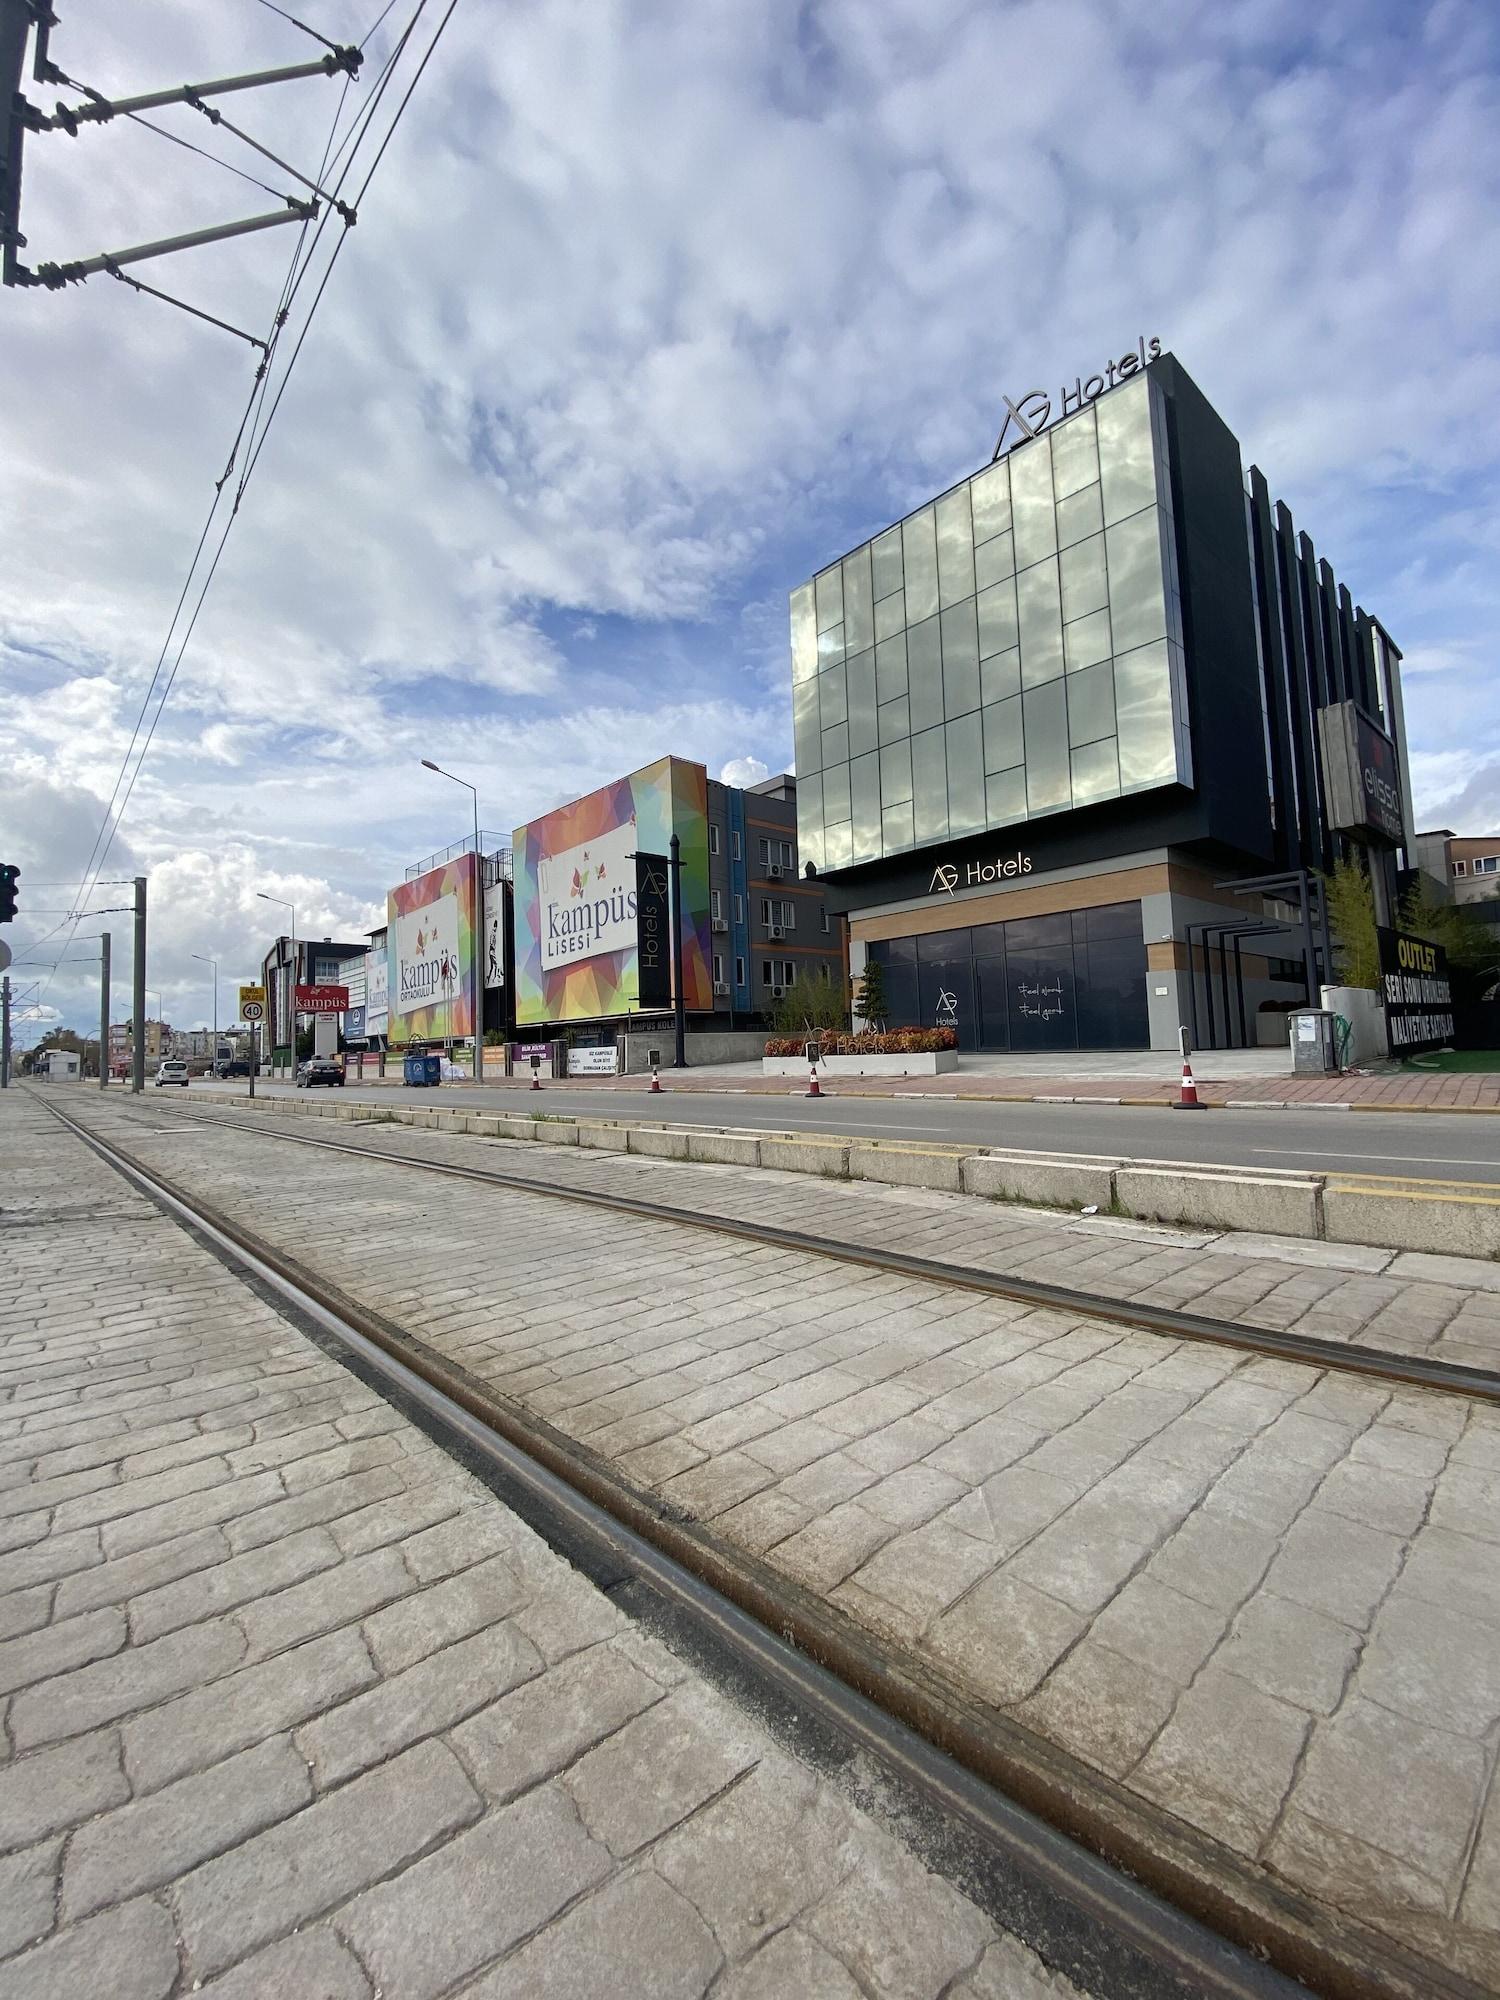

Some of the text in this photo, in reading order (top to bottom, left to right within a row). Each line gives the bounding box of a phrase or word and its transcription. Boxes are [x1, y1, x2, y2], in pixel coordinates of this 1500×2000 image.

[1060, 335, 1162, 417] Hotels
[1364, 767, 1400, 815] elissa
[966, 851, 1033, 885] Hotels
[547, 885, 638, 940] kampüs
[641, 905, 659, 968] Hotels
[1398, 939, 1436, 973] OUTLET
[246, 1006, 260, 1016] 40
[295, 995, 346, 1010] kampüs
[935, 1017, 959, 1026] Hotels
